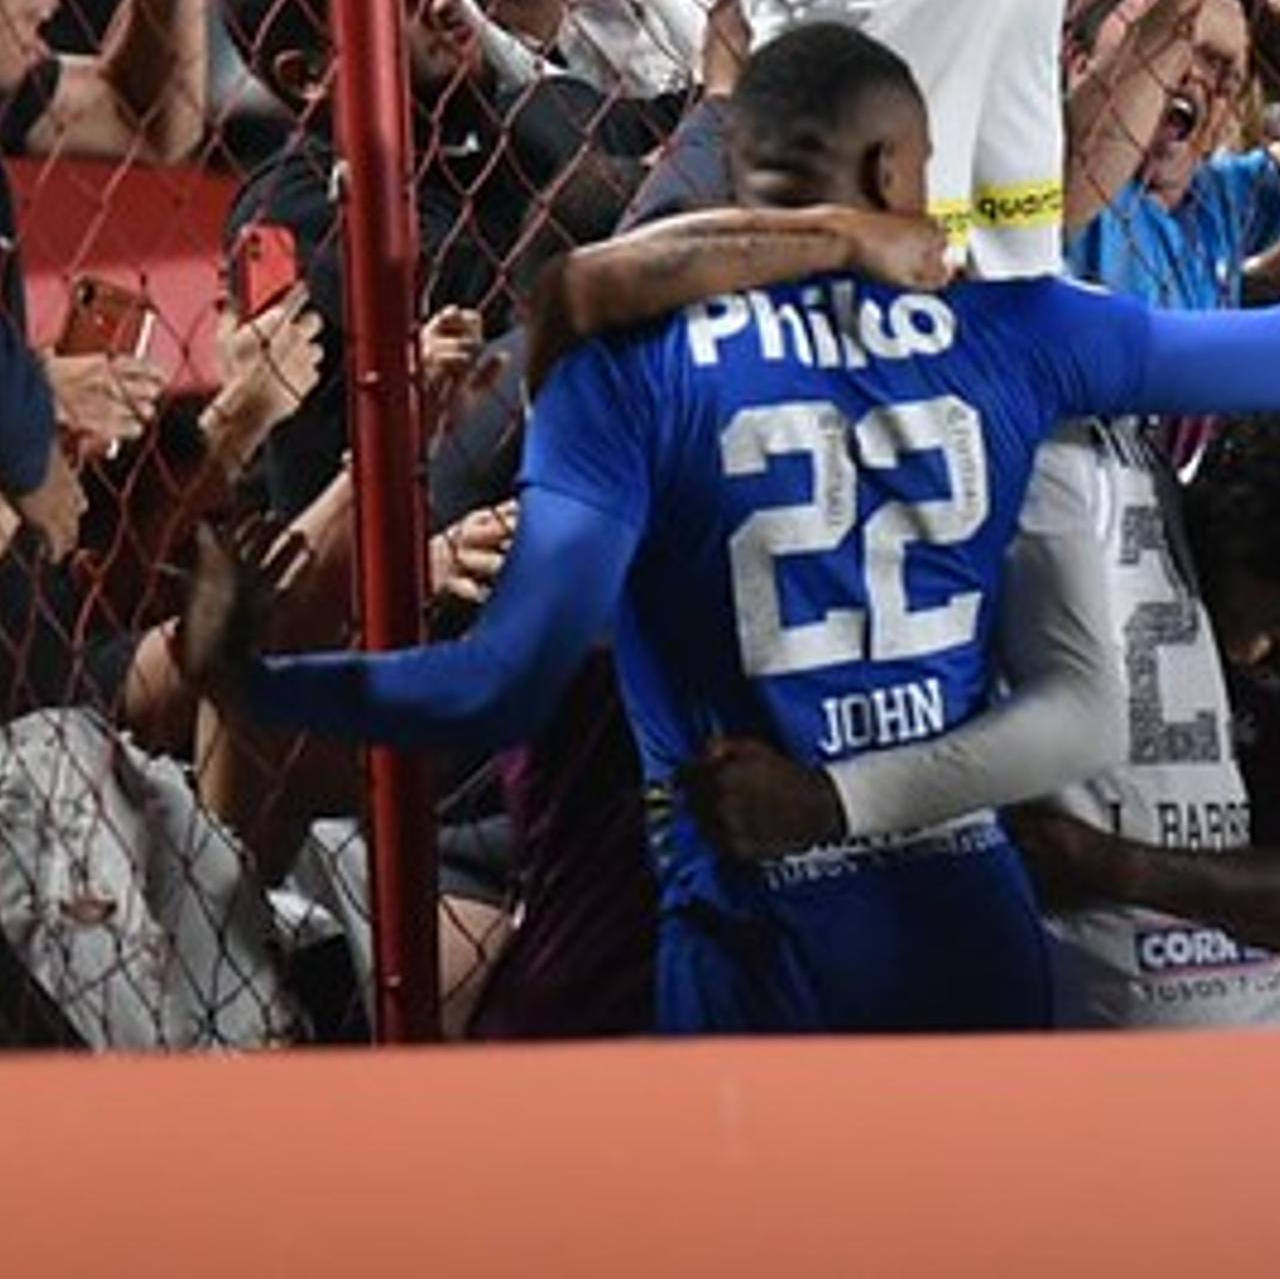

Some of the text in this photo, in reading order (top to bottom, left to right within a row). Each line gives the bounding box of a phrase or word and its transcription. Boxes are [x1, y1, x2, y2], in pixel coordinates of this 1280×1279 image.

[685, 277, 957, 368] Philco
[720, 395, 989, 677] 22
[819, 678, 944, 755] JOHN
